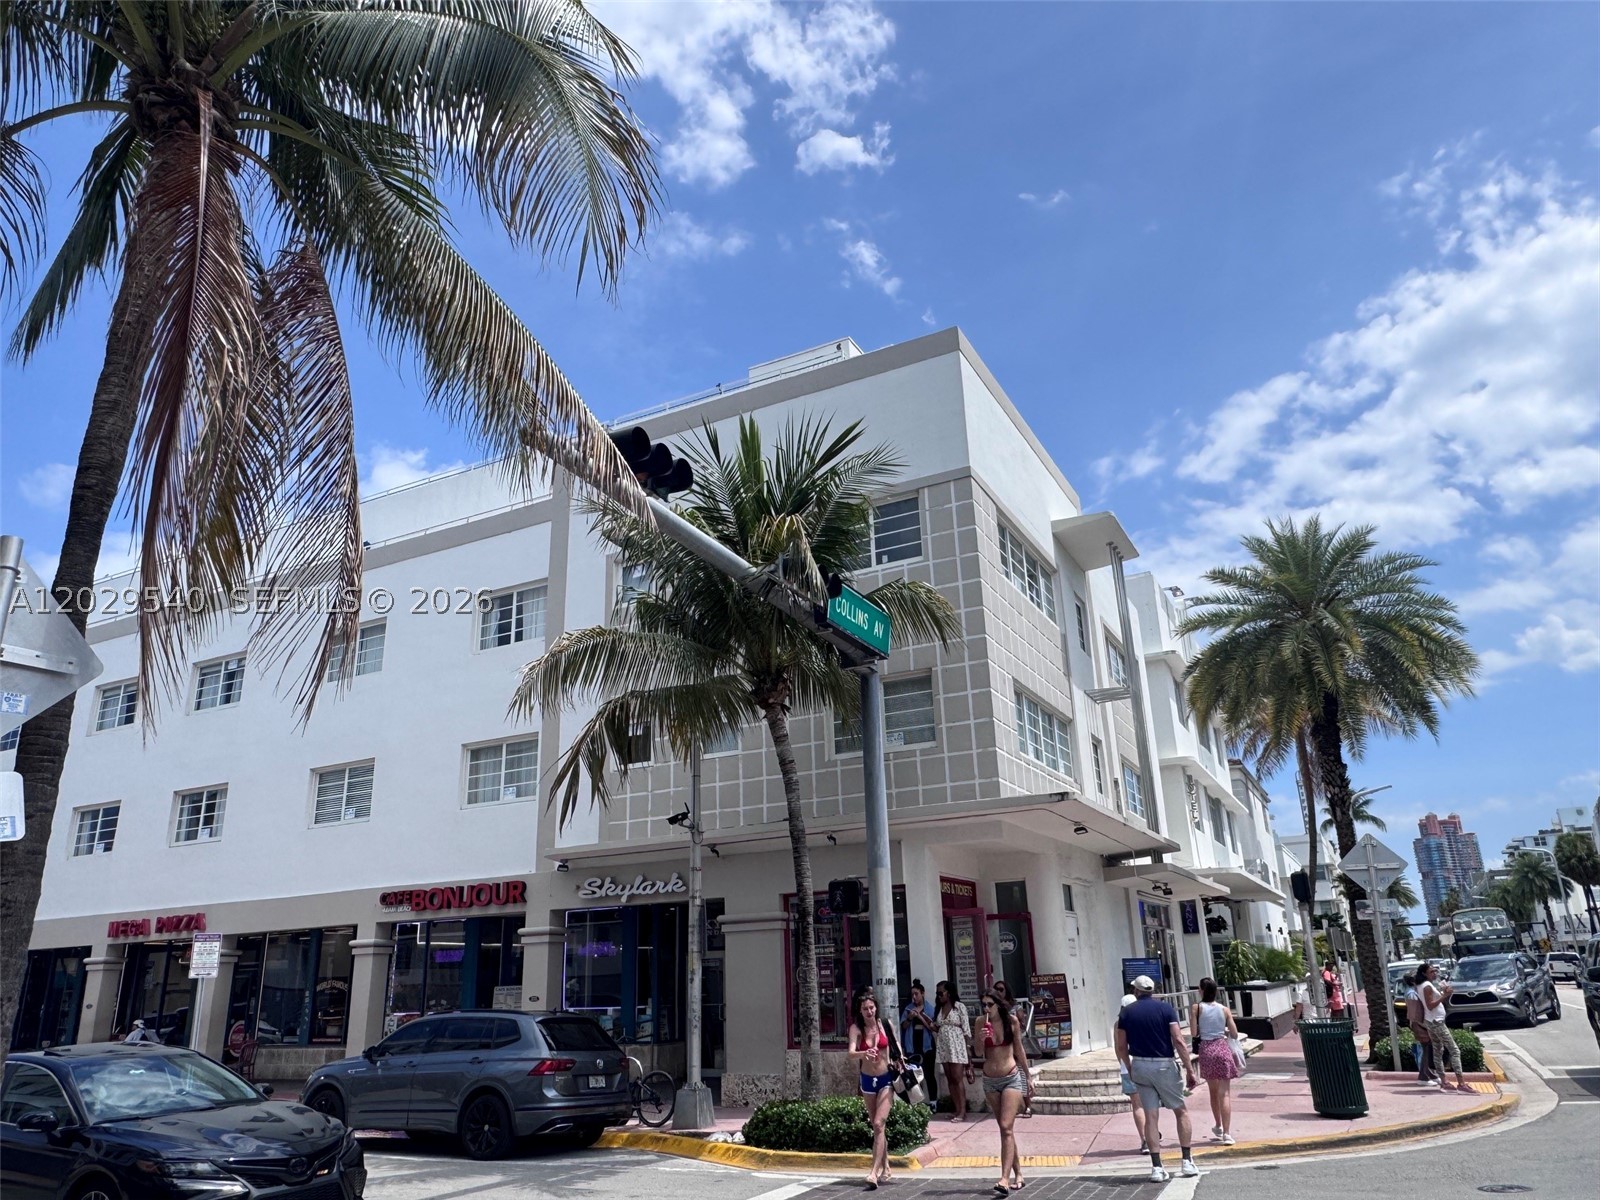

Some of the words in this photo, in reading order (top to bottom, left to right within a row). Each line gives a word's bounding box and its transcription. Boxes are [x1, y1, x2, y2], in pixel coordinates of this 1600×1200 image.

[836, 597, 868, 630] COLLINS
[873, 620, 884, 639] AV
[411, 880, 527, 911] BONJOUR
[578, 872, 686, 903] Skylark
[955, 884, 973, 897] TICKETS
[107, 919, 151, 938] MEGA
[155, 913, 206, 933] PIZZA
